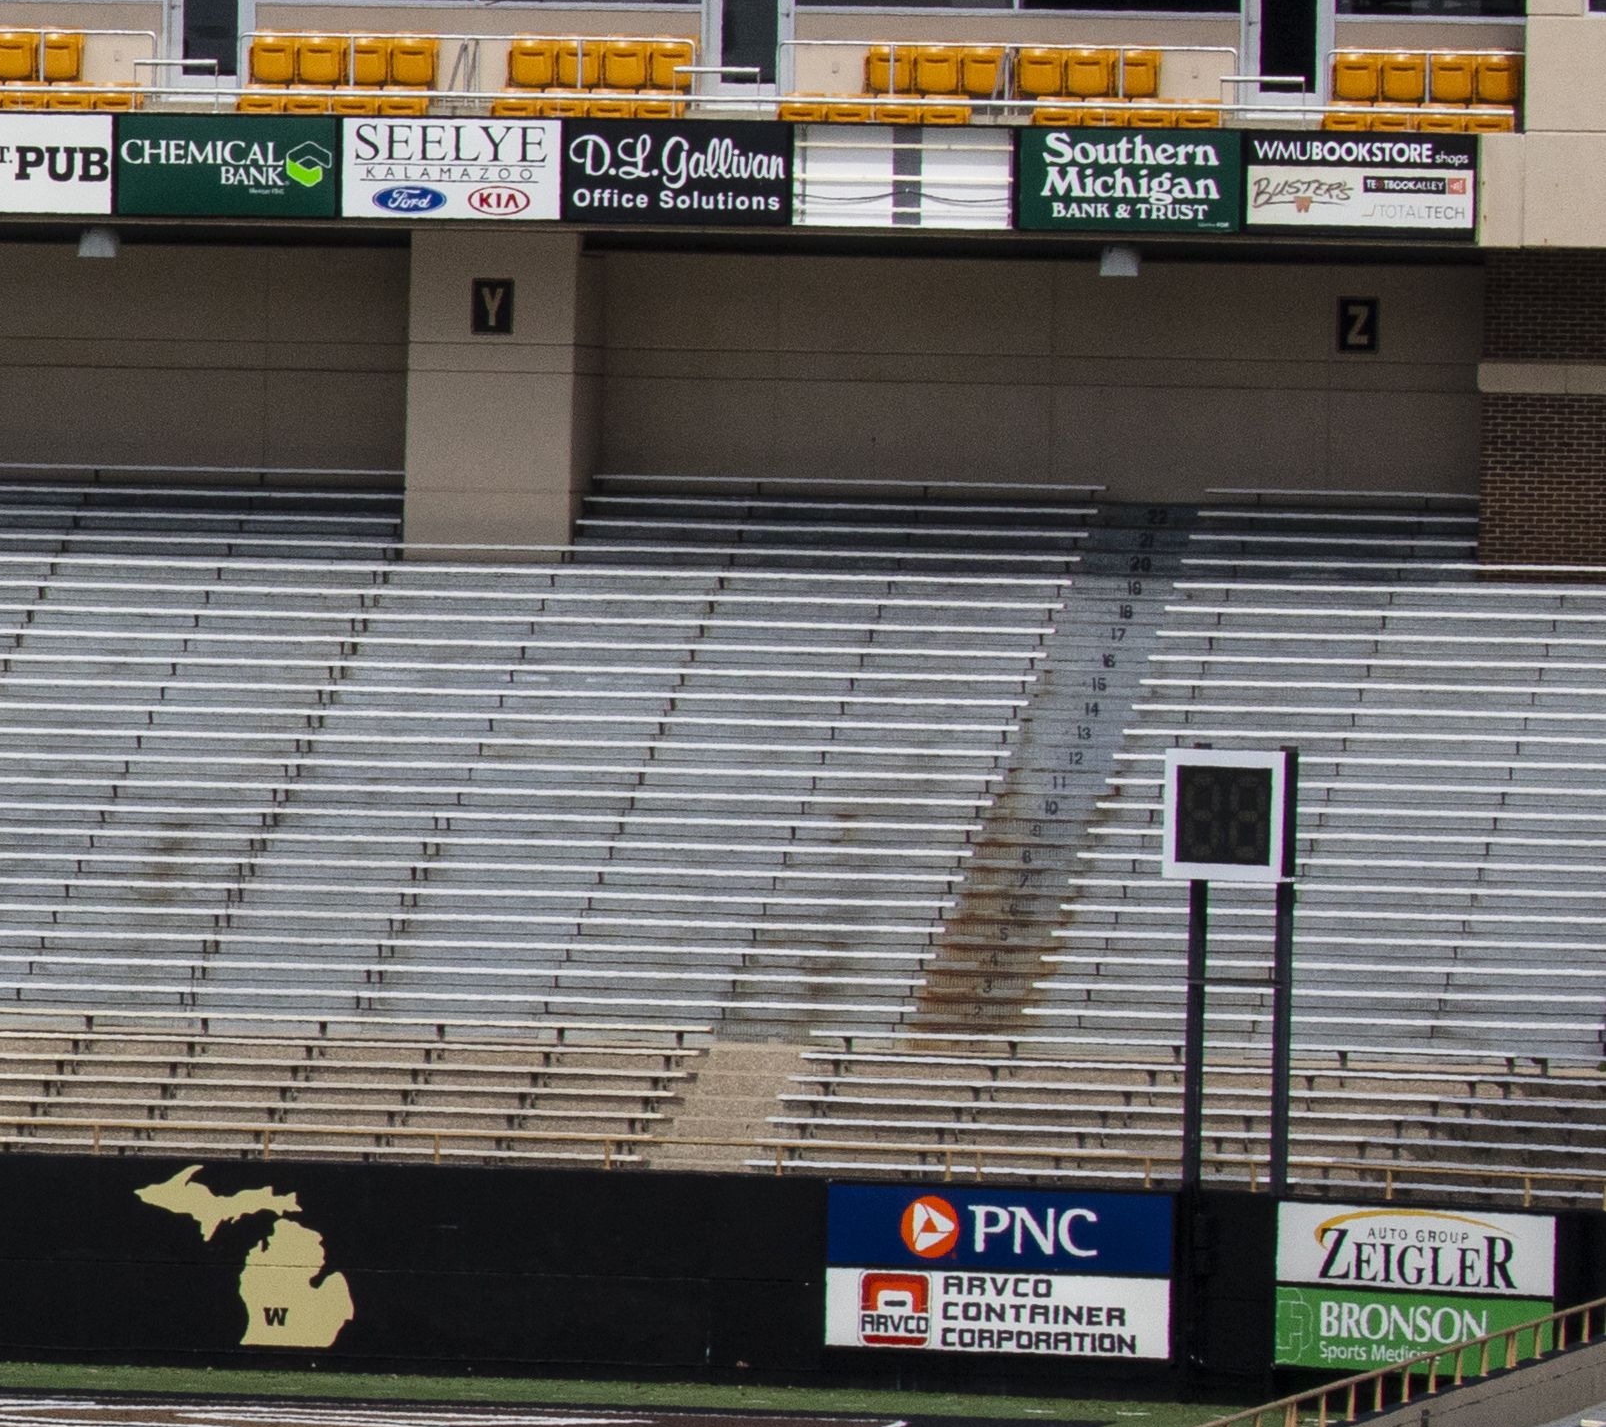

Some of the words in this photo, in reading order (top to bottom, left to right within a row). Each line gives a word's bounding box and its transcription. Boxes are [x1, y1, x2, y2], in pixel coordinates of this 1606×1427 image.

[121, 139, 284, 164] CHEMICAL
[356, 124, 548, 163] SEELYE
[1043, 133, 1219, 165] Southern
[16, 146, 108, 181] PUB
[1436, 151, 1468, 166] shops
[221, 167, 284, 186] BANK
[365, 167, 534, 180] KALAMAZOO
[1041, 167, 1220, 205] Michigan
[387, 190, 432, 209] Ford
[479, 193, 520, 209] KIA
[571, 189, 649, 208] Office
[659, 191, 781, 211] Solutions
[1052, 203, 1110, 217] BANK
[1116, 204, 1130, 218] &
[1136, 205, 1208, 219] TRUST
[482, 287, 504, 325] Y
[1347, 306, 1369, 344] Z
[968, 1205, 1099, 1257] PNC
[1367, 1228, 1408, 1241] AUTO
[1416, 1229, 1470, 1243] GROUP
[1318, 1228, 1517, 1290] ZEIGLER
[942, 1276, 1053, 1298] ARVCO
[263, 1306, 289, 1326] W
[861, 1314, 929, 1335] ARVCO
[942, 1301, 1126, 1326] CONTAINER
[1320, 1301, 1487, 1344] BRONSON
[941, 1327, 1137, 1355] CORPORATION
[1319, 1341, 1367, 1363] Sports
